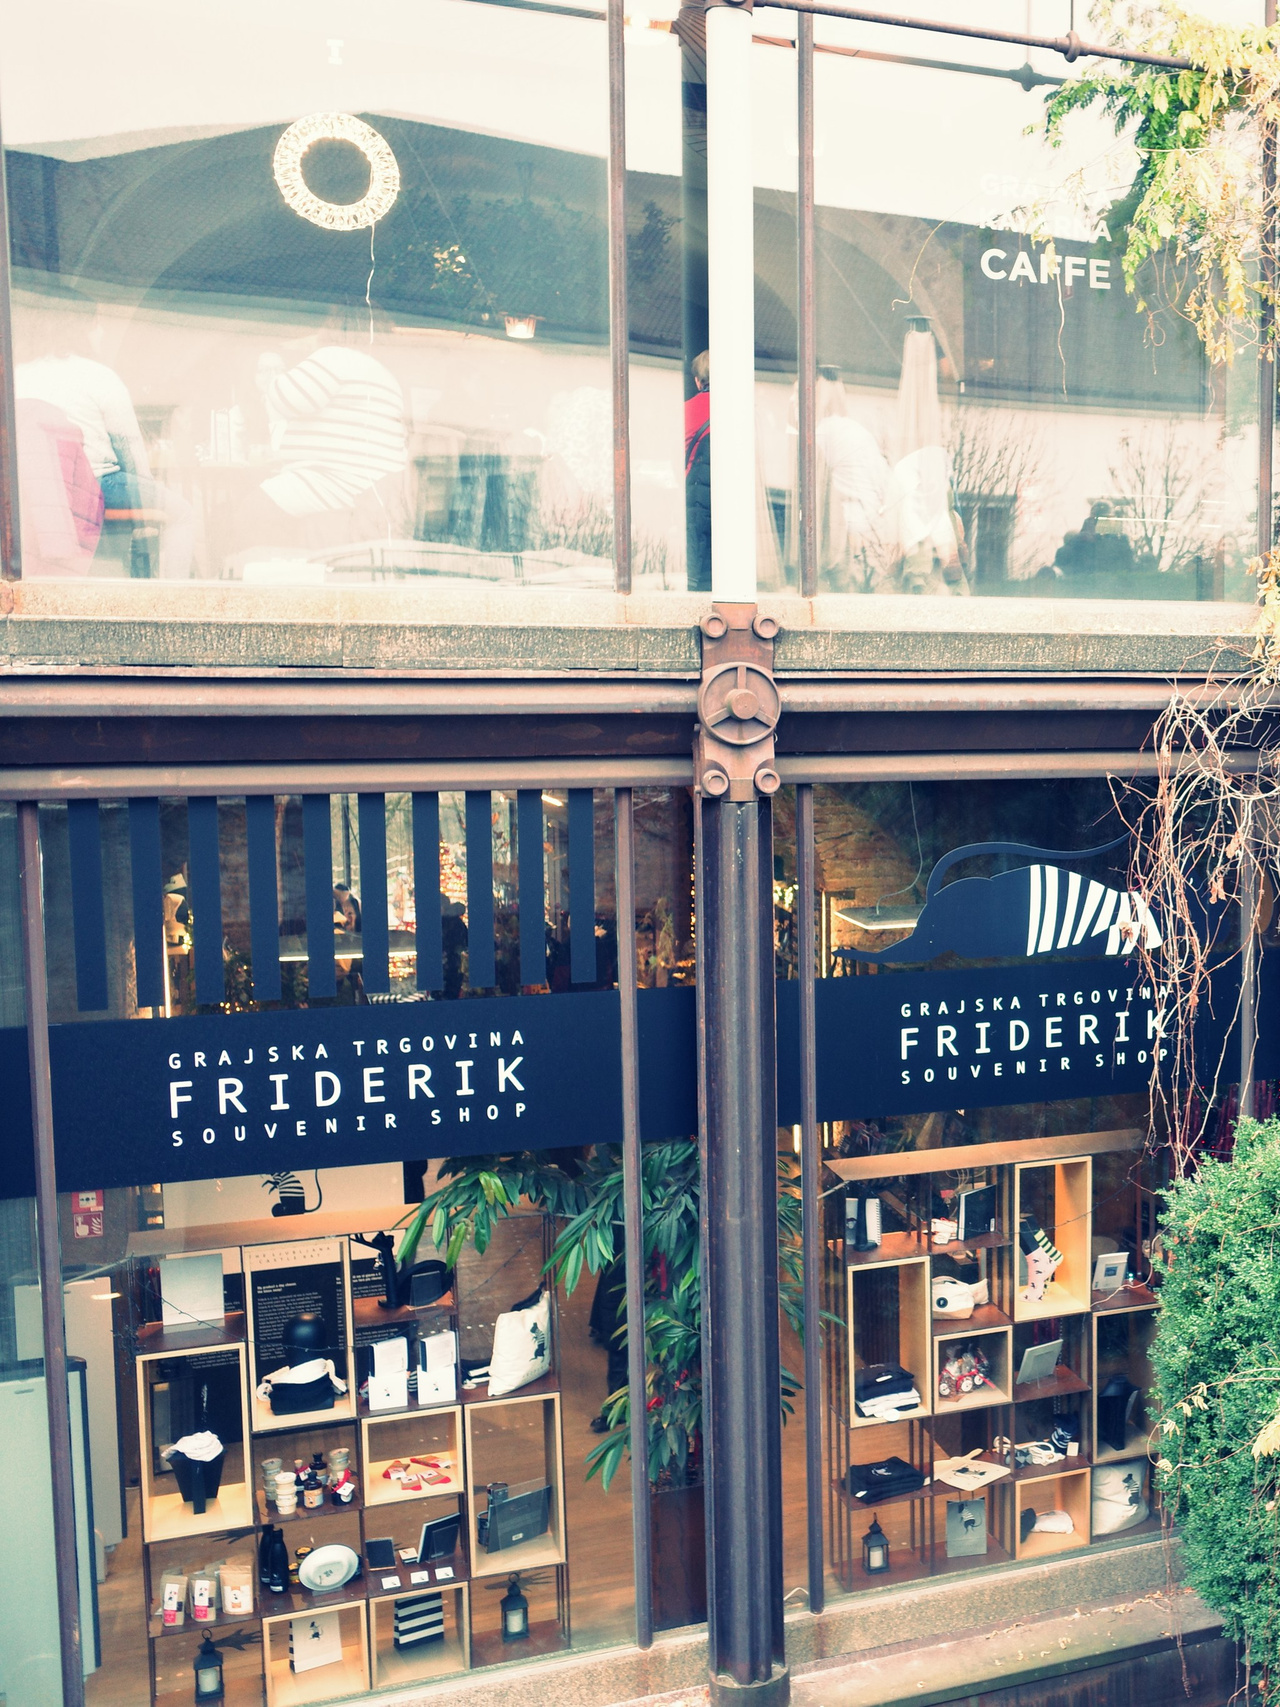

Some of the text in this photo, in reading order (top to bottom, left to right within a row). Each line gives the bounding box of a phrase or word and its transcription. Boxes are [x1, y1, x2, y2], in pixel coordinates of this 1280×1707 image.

[980, 248, 1112, 290] CAFFE
[900, 985, 1168, 1018] GRAJSKA TRGOVINA
[168, 1029, 524, 1070] GRAJSKA TRGOVINA
[900, 1009, 1168, 1061] FRIDERIK
[169, 1056, 525, 1119] FRIDERIK
[901, 1048, 1168, 1085] SOUVENIR SHOP
[171, 1102, 526, 1147] SOUVENIR SHOP
